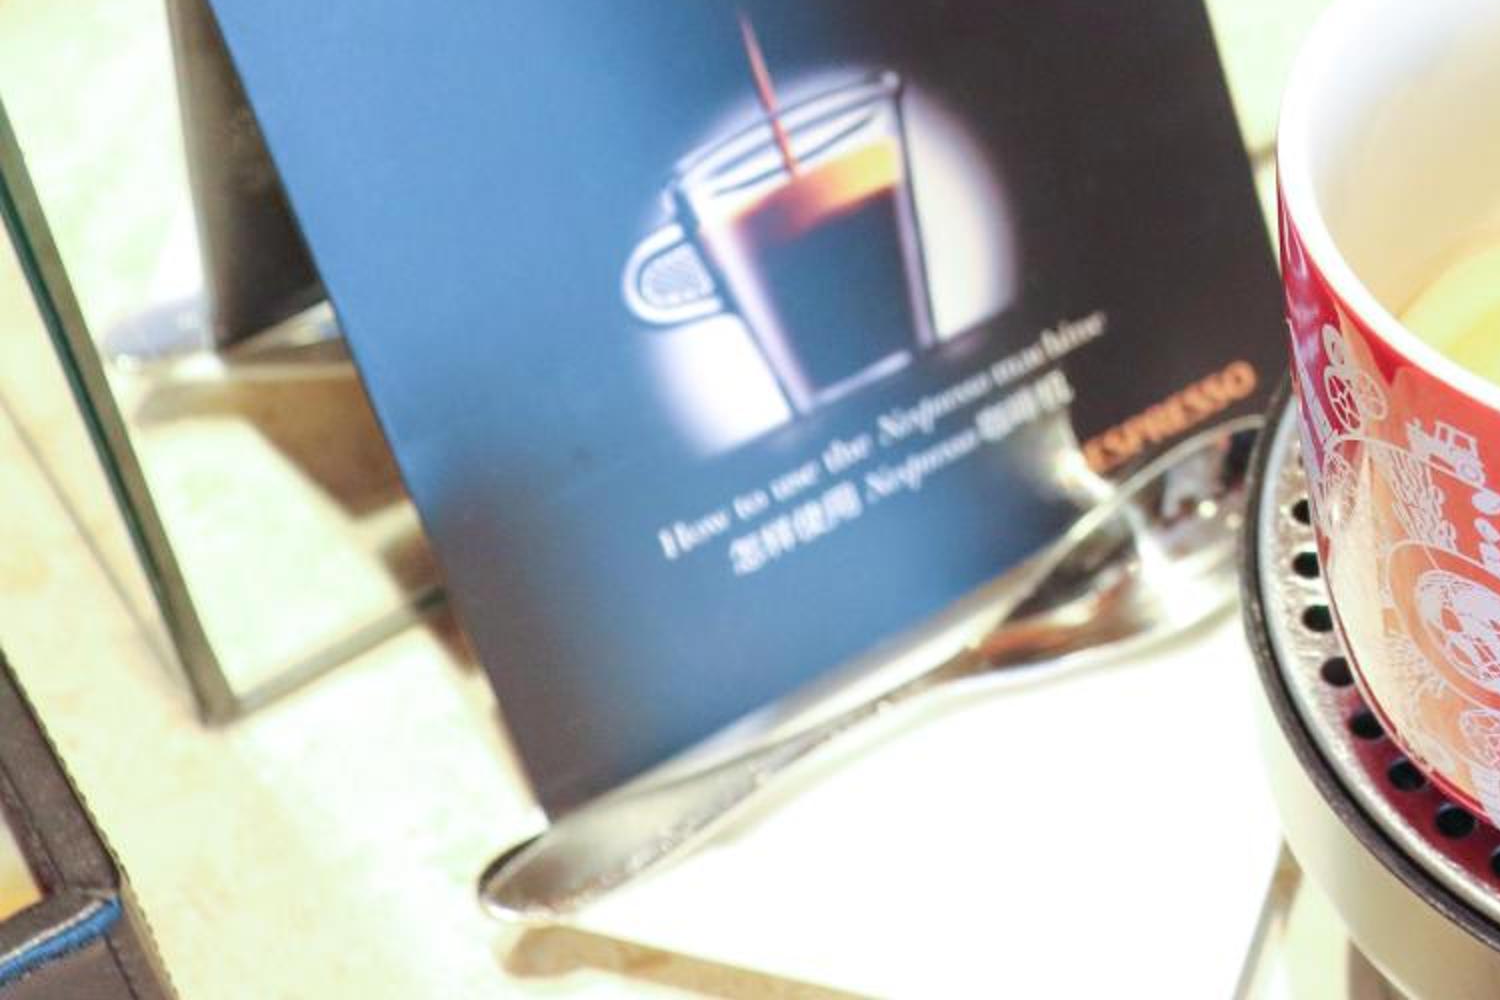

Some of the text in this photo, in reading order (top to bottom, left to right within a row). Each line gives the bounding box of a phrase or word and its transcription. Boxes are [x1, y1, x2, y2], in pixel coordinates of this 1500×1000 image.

[658, 509, 730, 559] How
[733, 489, 769, 520] to
[769, 460, 820, 502] use
[822, 433, 873, 474] the
[990, 311, 1107, 386] machine
